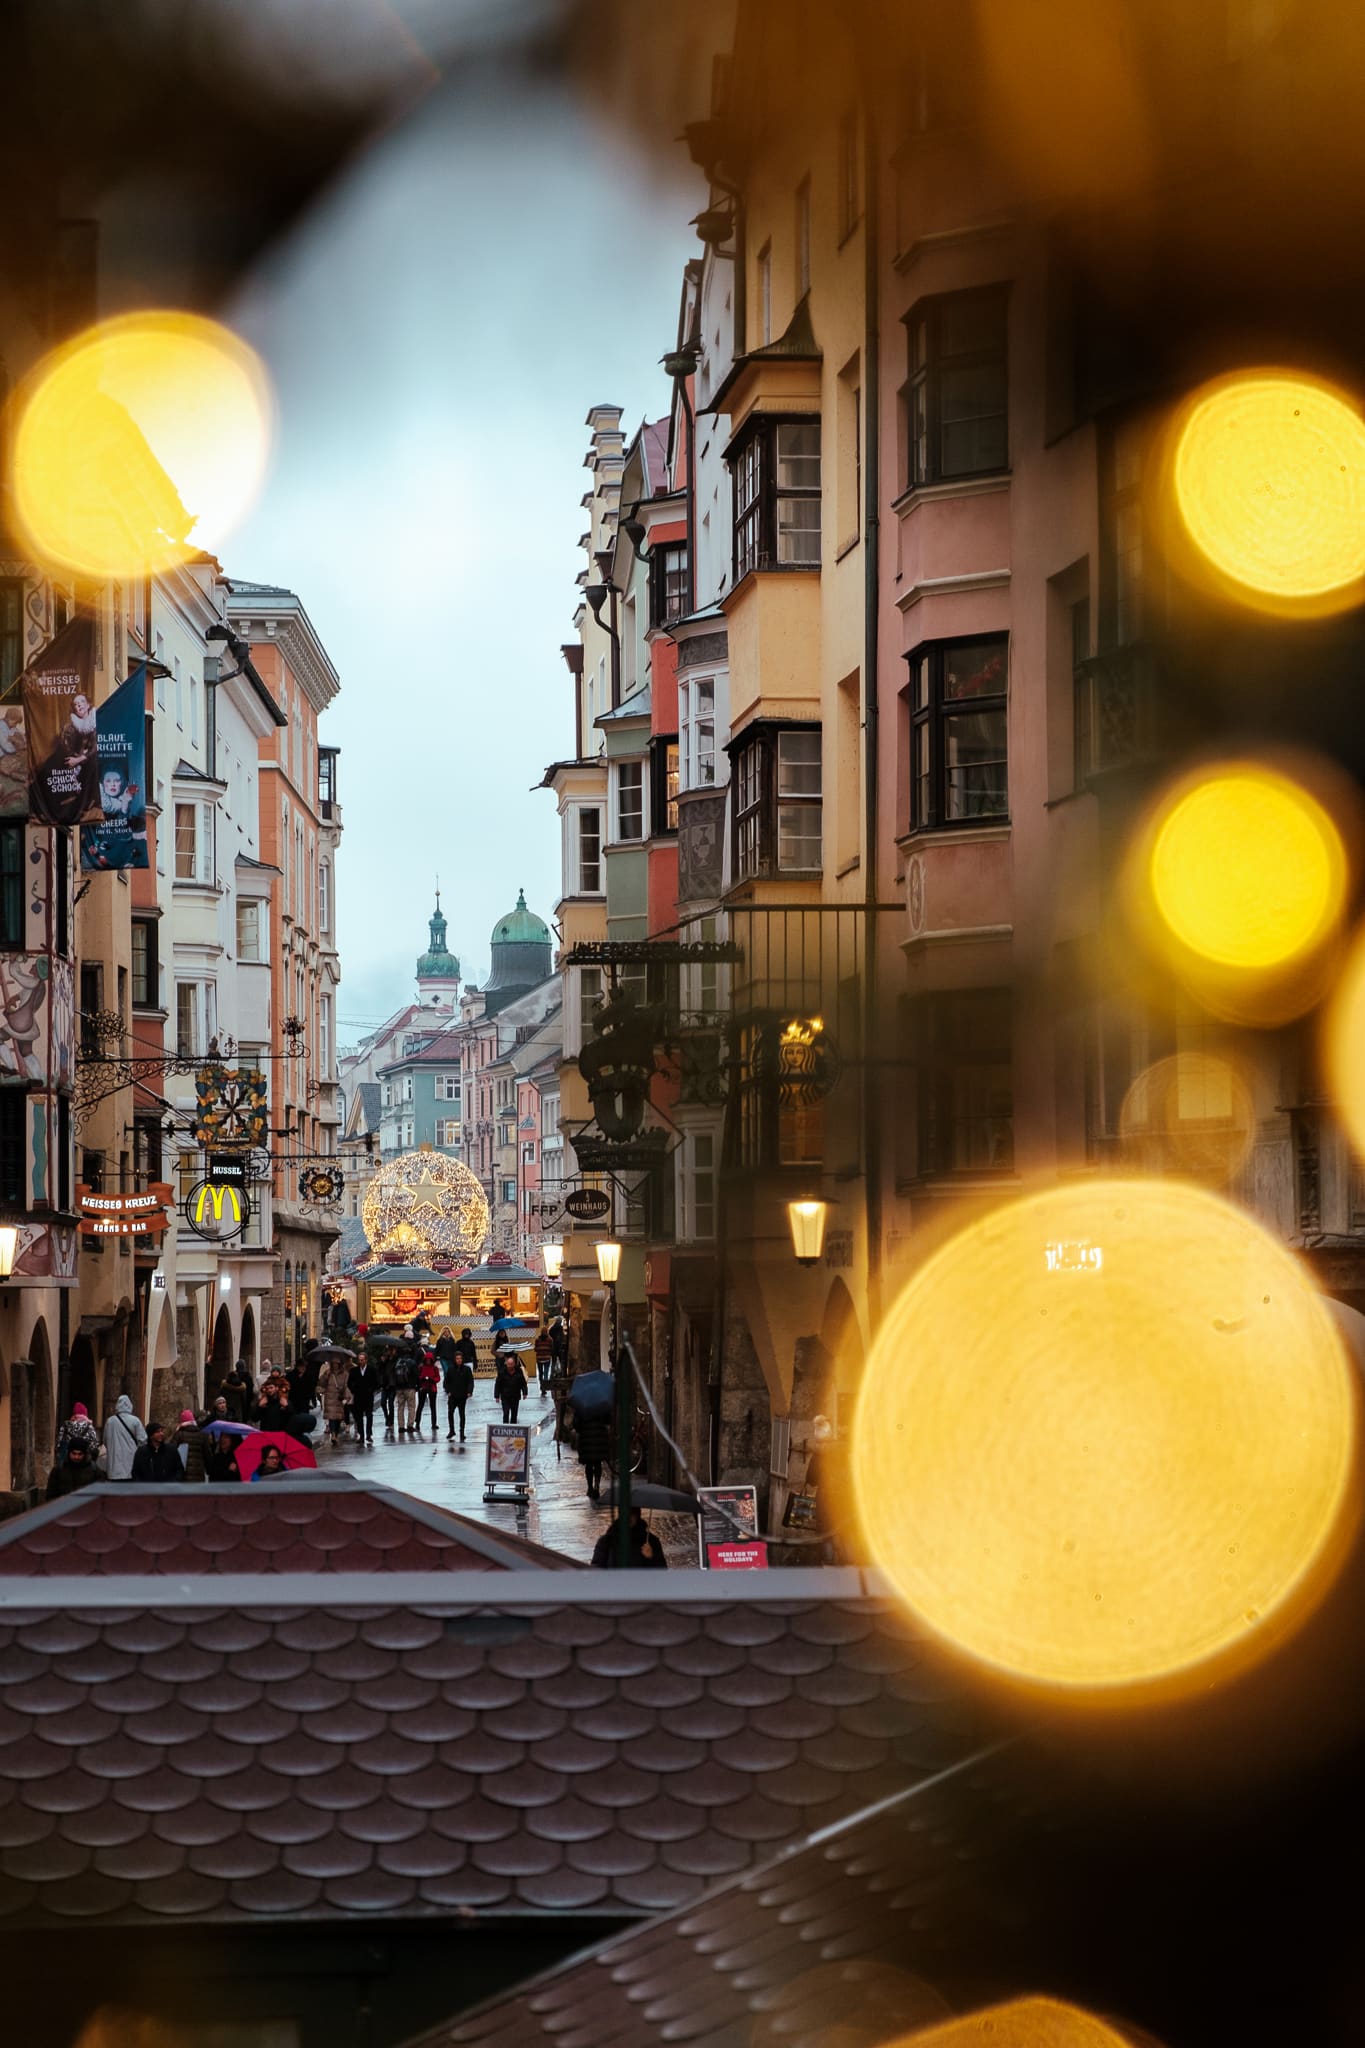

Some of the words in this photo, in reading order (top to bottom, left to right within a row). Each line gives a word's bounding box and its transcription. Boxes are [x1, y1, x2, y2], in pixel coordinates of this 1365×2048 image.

[38, 675, 80, 686] WEISSES
[42, 685, 77, 695] KREUZ
[97, 733, 126, 742] BLAUE
[96, 742, 133, 752] RIGITTE
[51, 782, 82, 793] SCHOCK
[212, 1166, 242, 1175] HUSSEL
[81, 1196, 122, 1209] WEISSES
[125, 1195, 157, 1209] KREUZ
[569, 1202, 607, 1212] WEINHAUS
[93, 1223, 120, 1232] ROOMS
[131, 1222, 147, 1232] BAR
[493, 1428, 526, 1437] CLINIQUE
